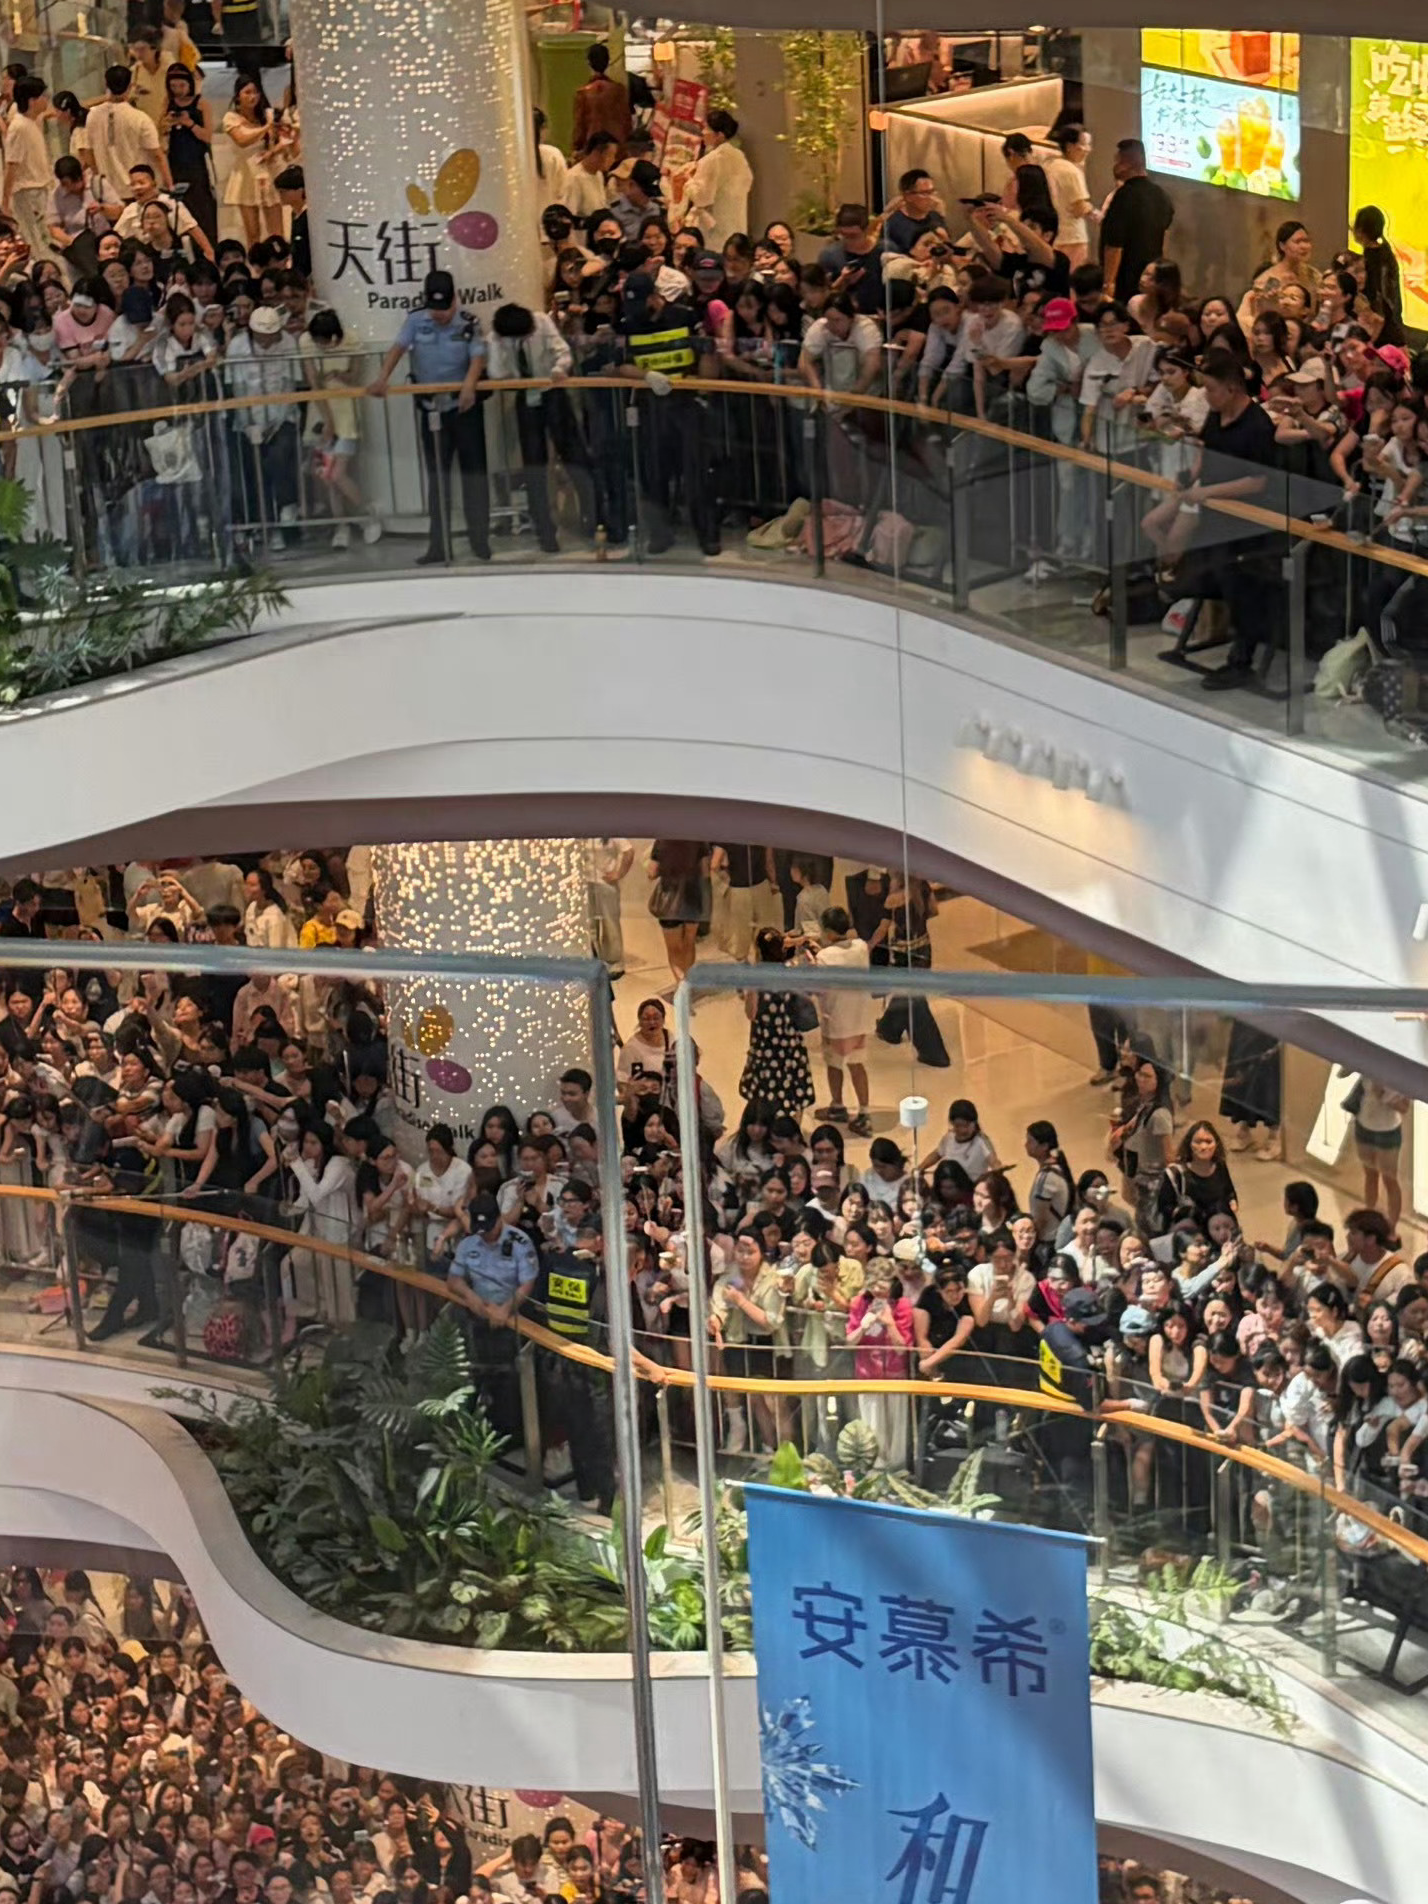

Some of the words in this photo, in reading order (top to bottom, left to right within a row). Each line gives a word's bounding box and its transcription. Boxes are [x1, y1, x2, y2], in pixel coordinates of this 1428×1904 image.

[327, 220, 442, 285] 天街
[458, 283, 503, 305] Walk
[792, 1581, 1049, 1697] 安慕希
